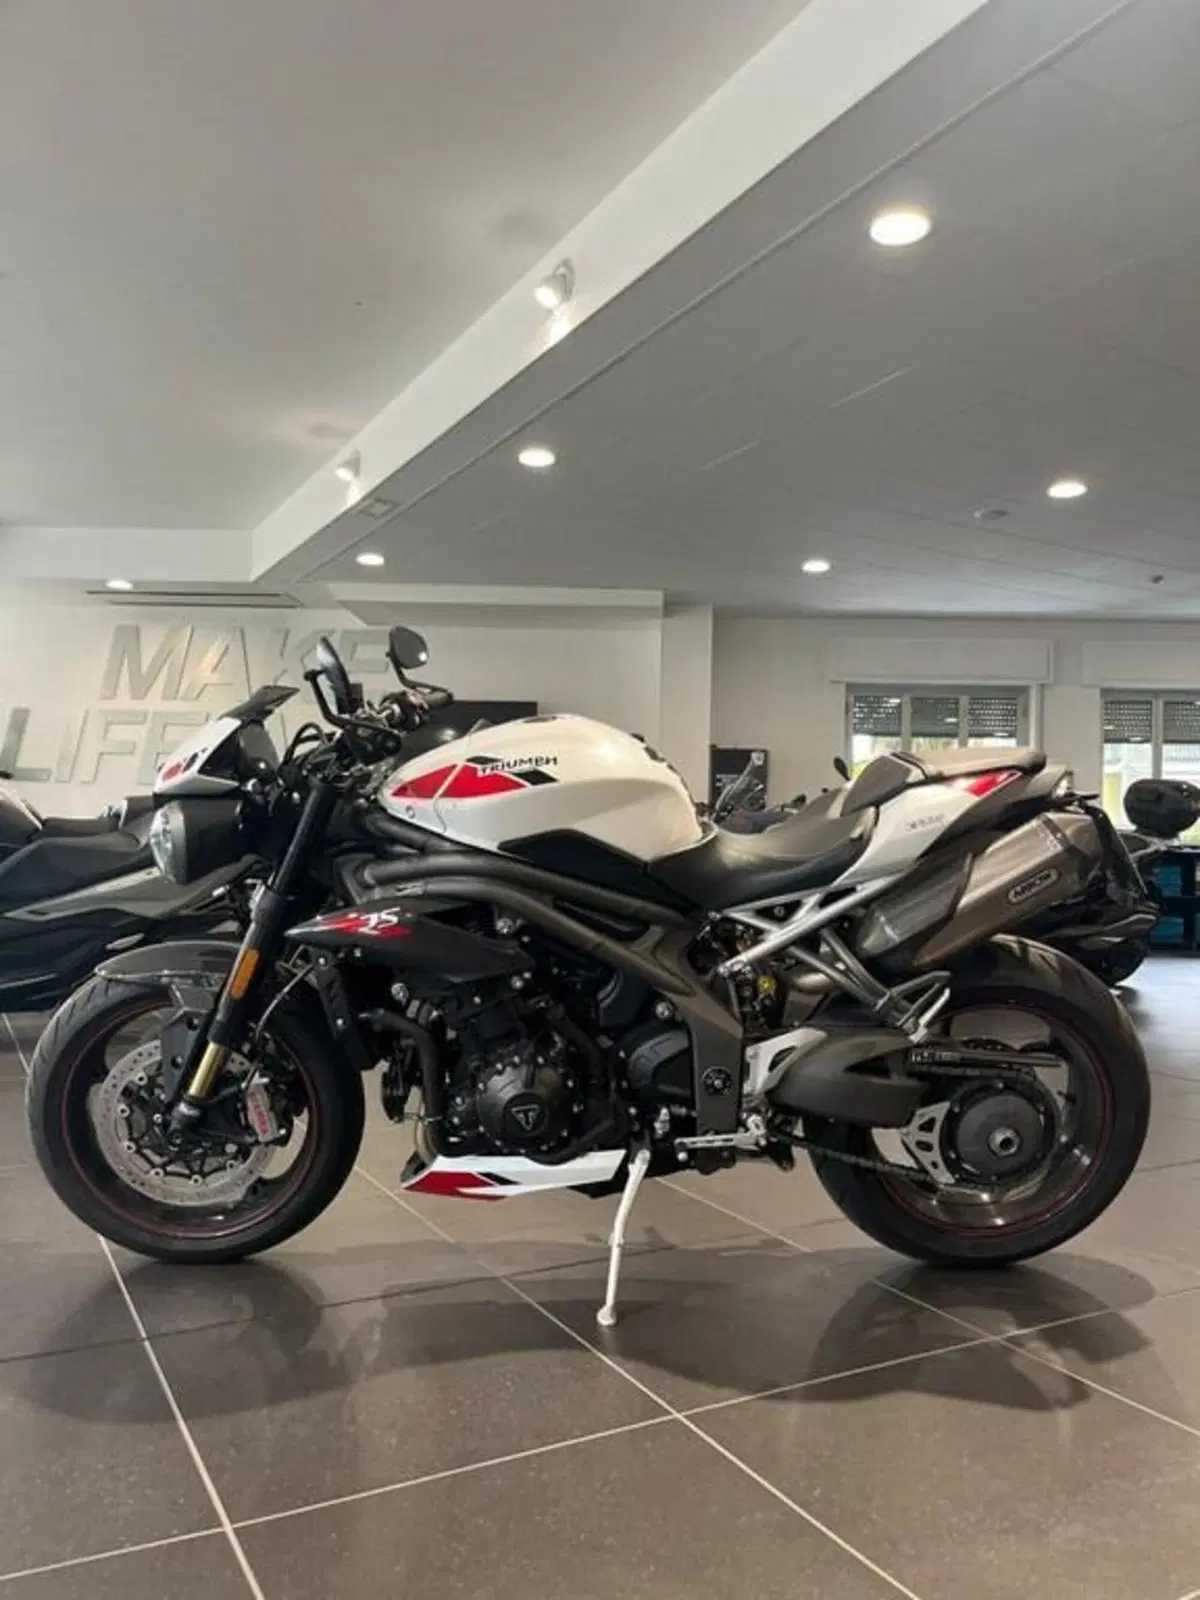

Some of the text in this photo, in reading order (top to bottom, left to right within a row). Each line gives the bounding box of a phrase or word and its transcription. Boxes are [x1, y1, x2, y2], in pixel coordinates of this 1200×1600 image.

[101, 624, 394, 706] MAKE
[1, 706, 209, 785] LIFE
[480, 755, 558, 775] TRIUMPH
